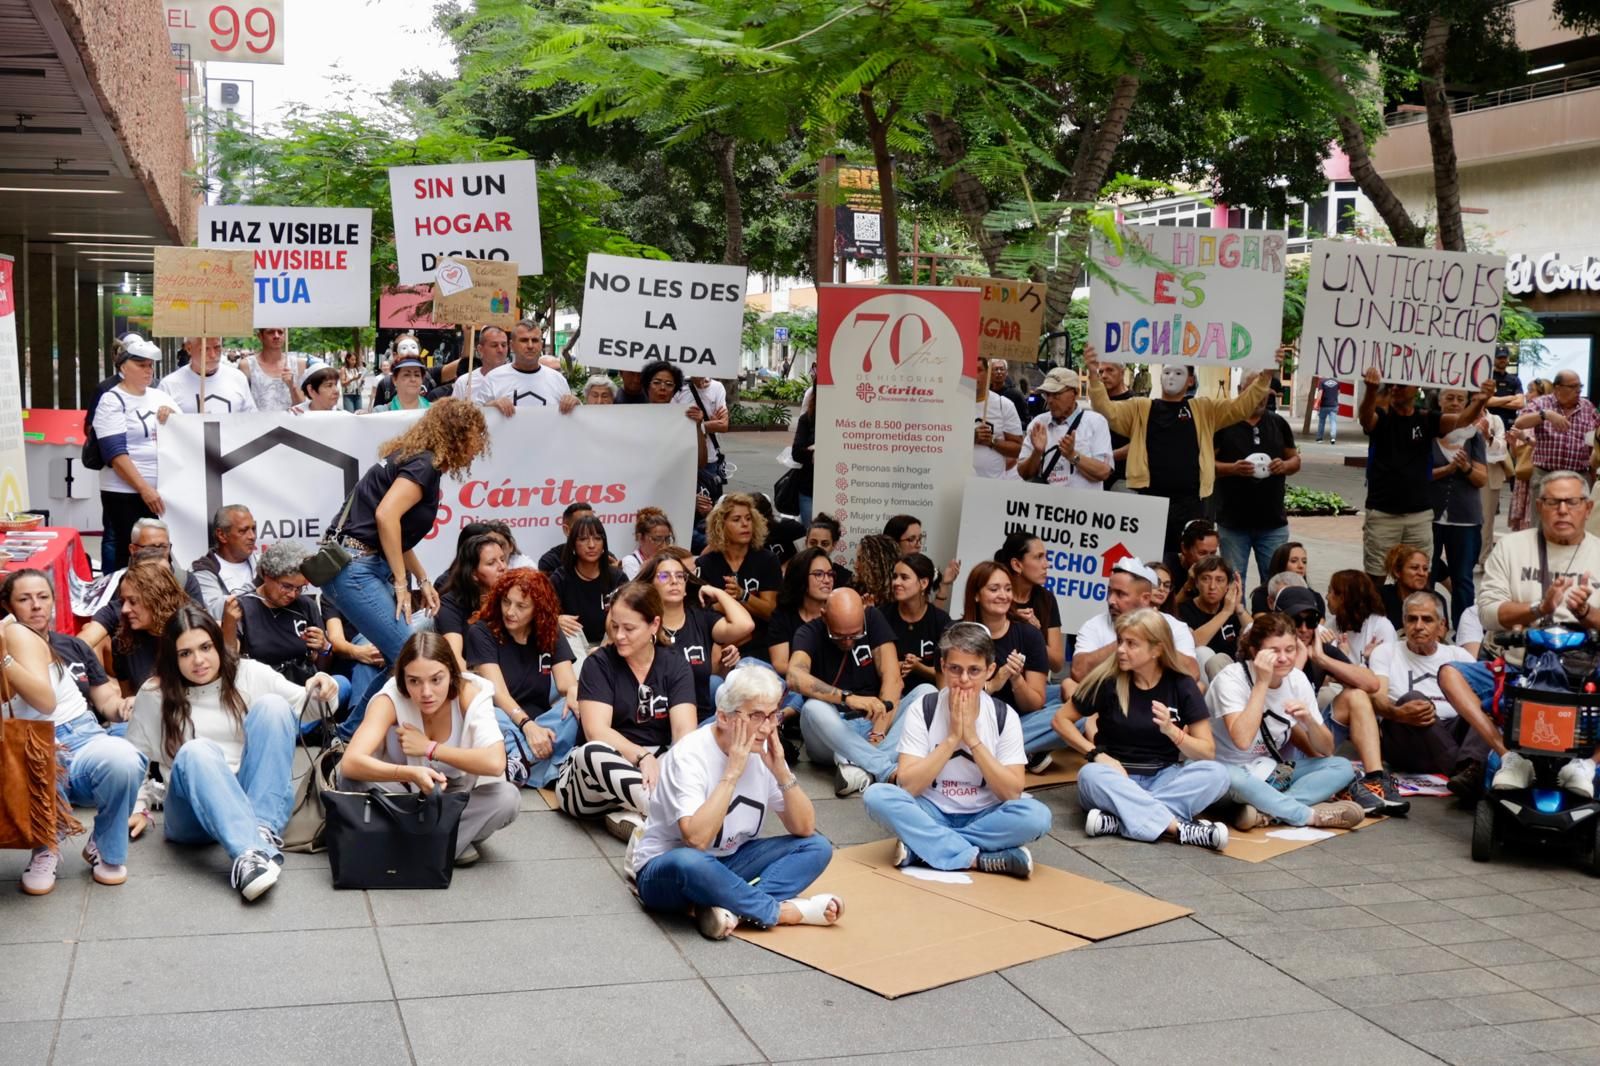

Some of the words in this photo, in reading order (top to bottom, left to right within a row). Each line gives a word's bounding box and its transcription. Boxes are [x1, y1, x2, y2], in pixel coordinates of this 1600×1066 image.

[168, 9, 197, 29] EL
[209, 5, 276, 55] 99
[414, 177, 454, 200] SIN
[462, 174, 506, 196] UN
[211, 220, 261, 243] HAZ
[269, 222, 359, 245] VISIBLE
[415, 211, 513, 237] HOGAR
[254, 250, 347, 270] NVISIBLE
[421, 248, 510, 272] DNO
[1172, 232, 1284, 273] HOGAR
[1322, 252, 1380, 296] UN
[1387, 253, 1464, 304] TECHO
[1471, 263, 1505, 308] ES
[1505, 252, 1533, 295] El
[589, 271, 631, 293] NO
[638, 277, 683, 299] LES
[690, 282, 740, 302] DES
[1153, 271, 1206, 308] ES
[644, 310, 678, 331] LA
[978, 316, 1020, 342] IGNA
[1334, 297, 1395, 331] UN
[1392, 300, 1498, 343] DERECHO
[598, 337, 717, 366] ESPALDA
[853, 313, 932, 372] 70
[1315, 336, 1357, 378] NO
[878, 384, 934, 396] Cáritas
[835, 418, 857, 429] Más
[859, 419, 872, 429] de
[875, 420, 902, 430] 8.500
[904, 422, 953, 433] personas
[842, 430, 923, 443] comprometidas
[925, 434, 945, 442] con
[843, 442, 889, 452] nuestros
[891, 443, 944, 454] proyectos
[851, 463, 891, 473] Personas
[893, 464, 905, 473] sin
[906, 465, 931, 475] hogar
[458, 478, 626, 509] Cáritas
[850, 479, 890, 489] Personas
[891, 480, 934, 491] migrantes
[850, 496, 883, 506] Empleo
[884, 498, 890, 507] y
[890, 496, 933, 507] formación
[255, 518, 320, 539] ADIE
[850, 511, 873, 521] Mujer
[875, 514, 881, 522] y
[1006, 500, 1030, 518] UN
[1035, 503, 1088, 526] TECHO
[1092, 511, 1116, 530] NO
[1120, 516, 1139, 534] ES
[1079, 532, 1099, 549] ES
[942, 780, 958, 788] SIN
[942, 787, 978, 798] HOGAR
